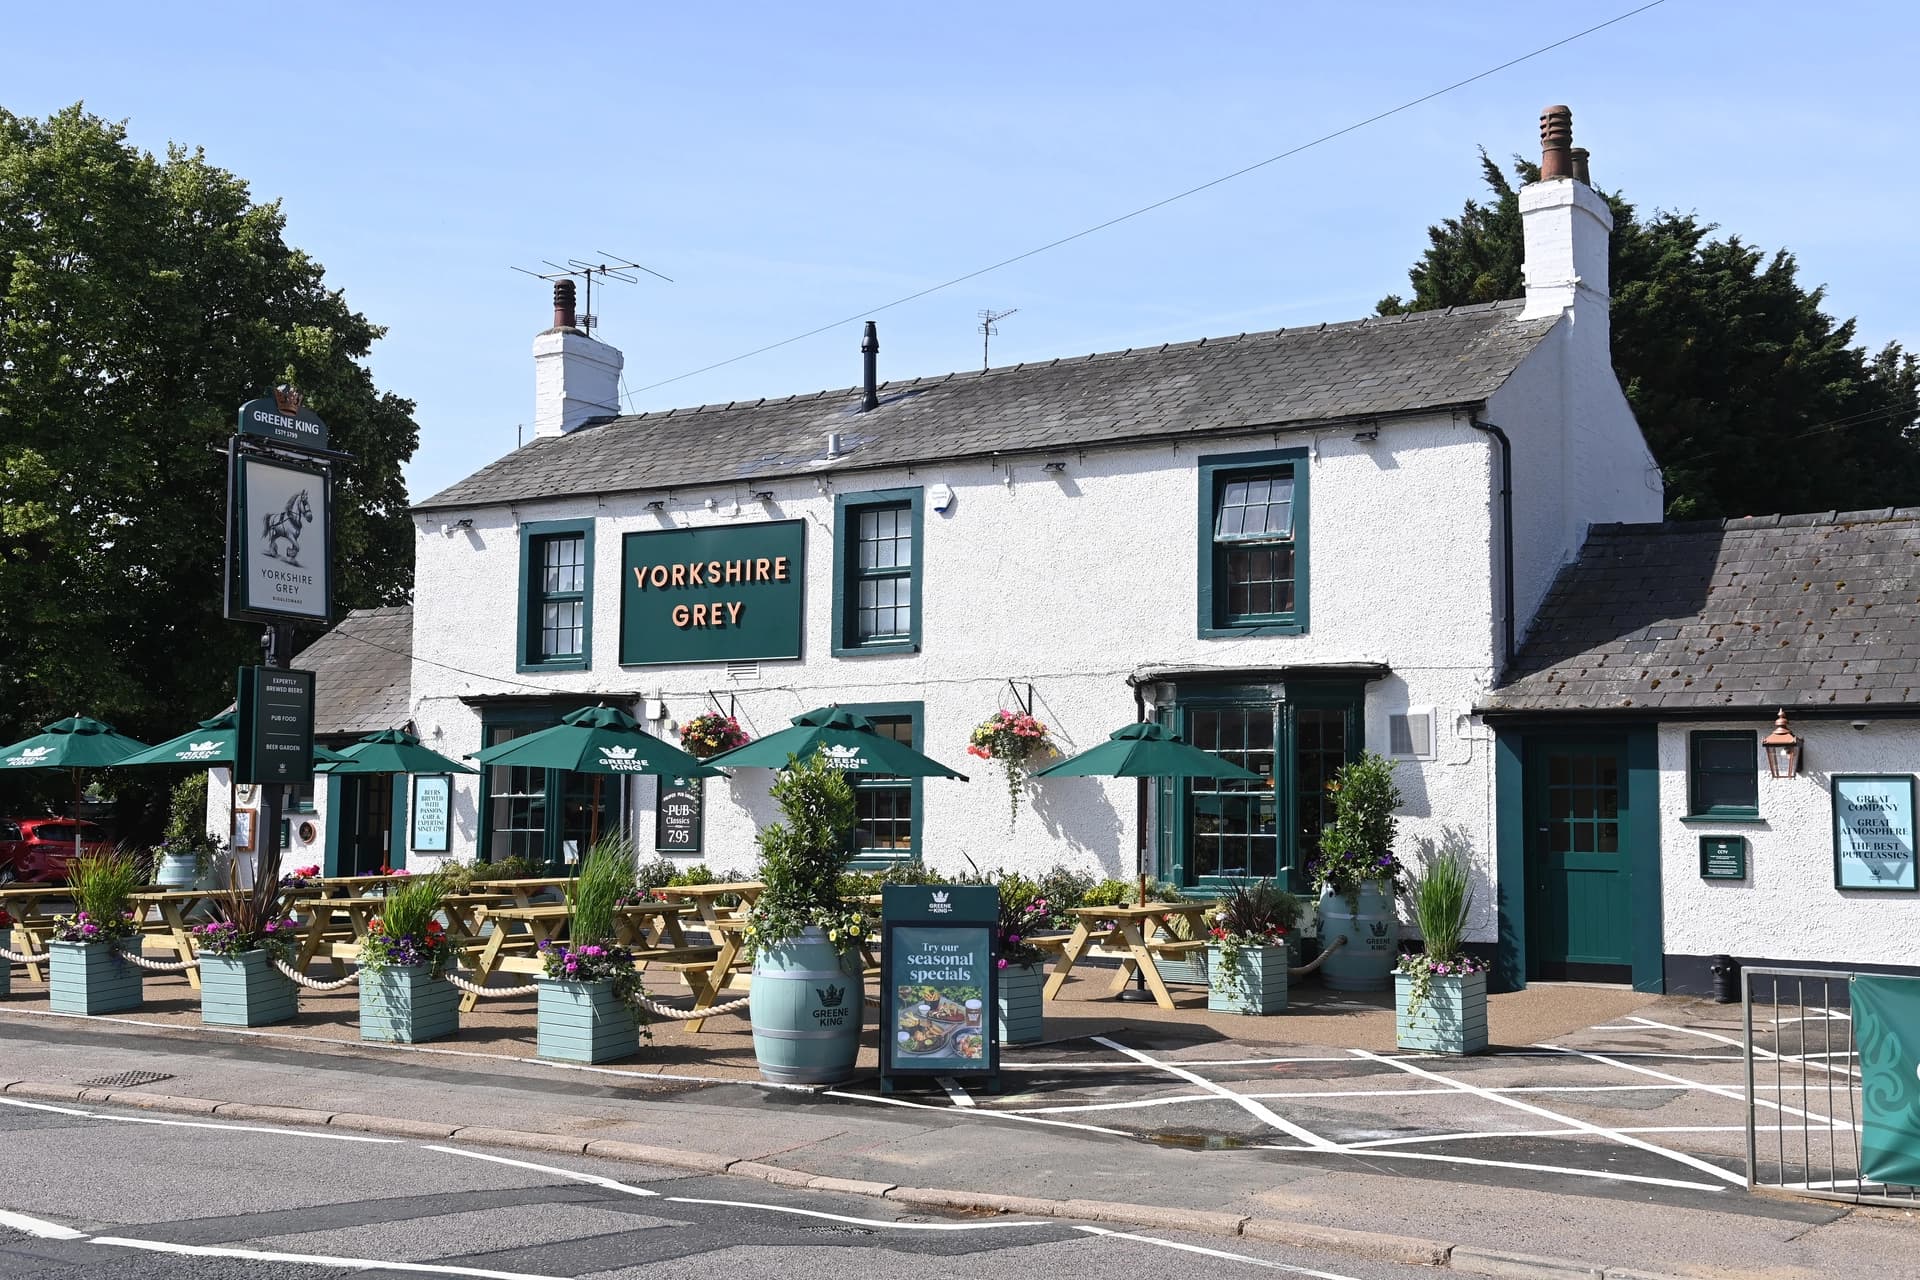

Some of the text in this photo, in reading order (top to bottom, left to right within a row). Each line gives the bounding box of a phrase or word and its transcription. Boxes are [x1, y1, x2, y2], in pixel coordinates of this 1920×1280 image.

[254, 410, 319, 434] GREENE KING
[262, 568, 312, 585] YORKSHIRE
[633, 556, 787, 588] YORKSHIRE
[276, 583, 300, 594] GREY
[672, 601, 742, 627] GREY
[1856, 795, 1889, 803] GREAT
[668, 805, 690, 816] PUB
[1842, 828, 1908, 836] ATMOSPHERE
[1851, 842, 1871, 850] THE
[1842, 851, 1909, 859] PUB CLASSICS
[922, 943, 959, 953] Try our
[907, 952, 973, 965] seasonal
[910, 967, 971, 983] specials
[812, 1008, 849, 1018] GREENE
[820, 1018, 843, 1027] KING
